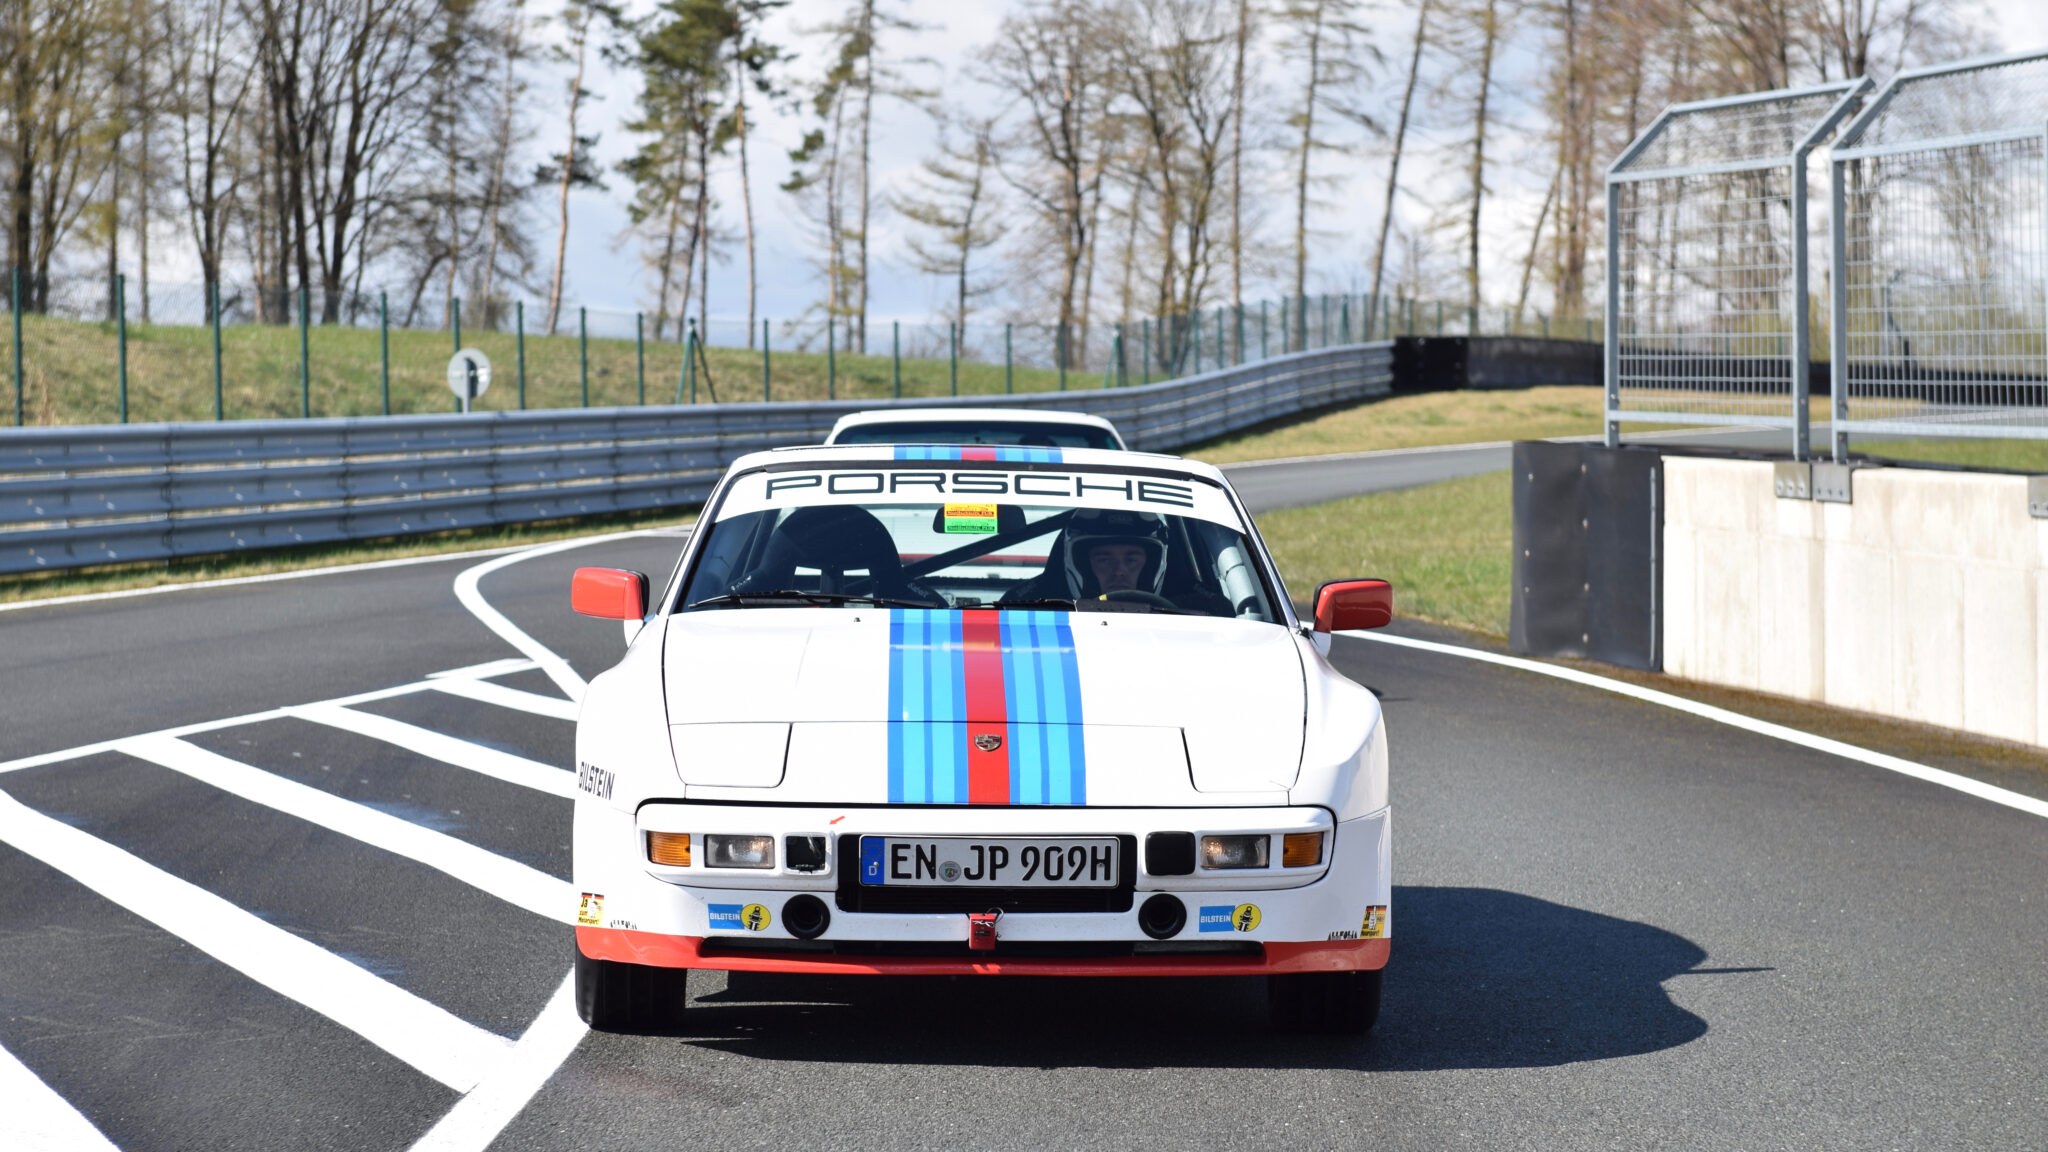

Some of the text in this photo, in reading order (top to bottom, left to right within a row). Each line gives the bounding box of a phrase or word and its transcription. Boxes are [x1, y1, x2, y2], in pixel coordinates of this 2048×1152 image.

[765, 472, 1194, 508] PORSCHE
[579, 761, 615, 800] BILSTEIN
[891, 843, 1111, 881] EN JP 909H
[709, 912, 741, 921] BILSTEIN
[1200, 914, 1232, 923] BILSTEIN
